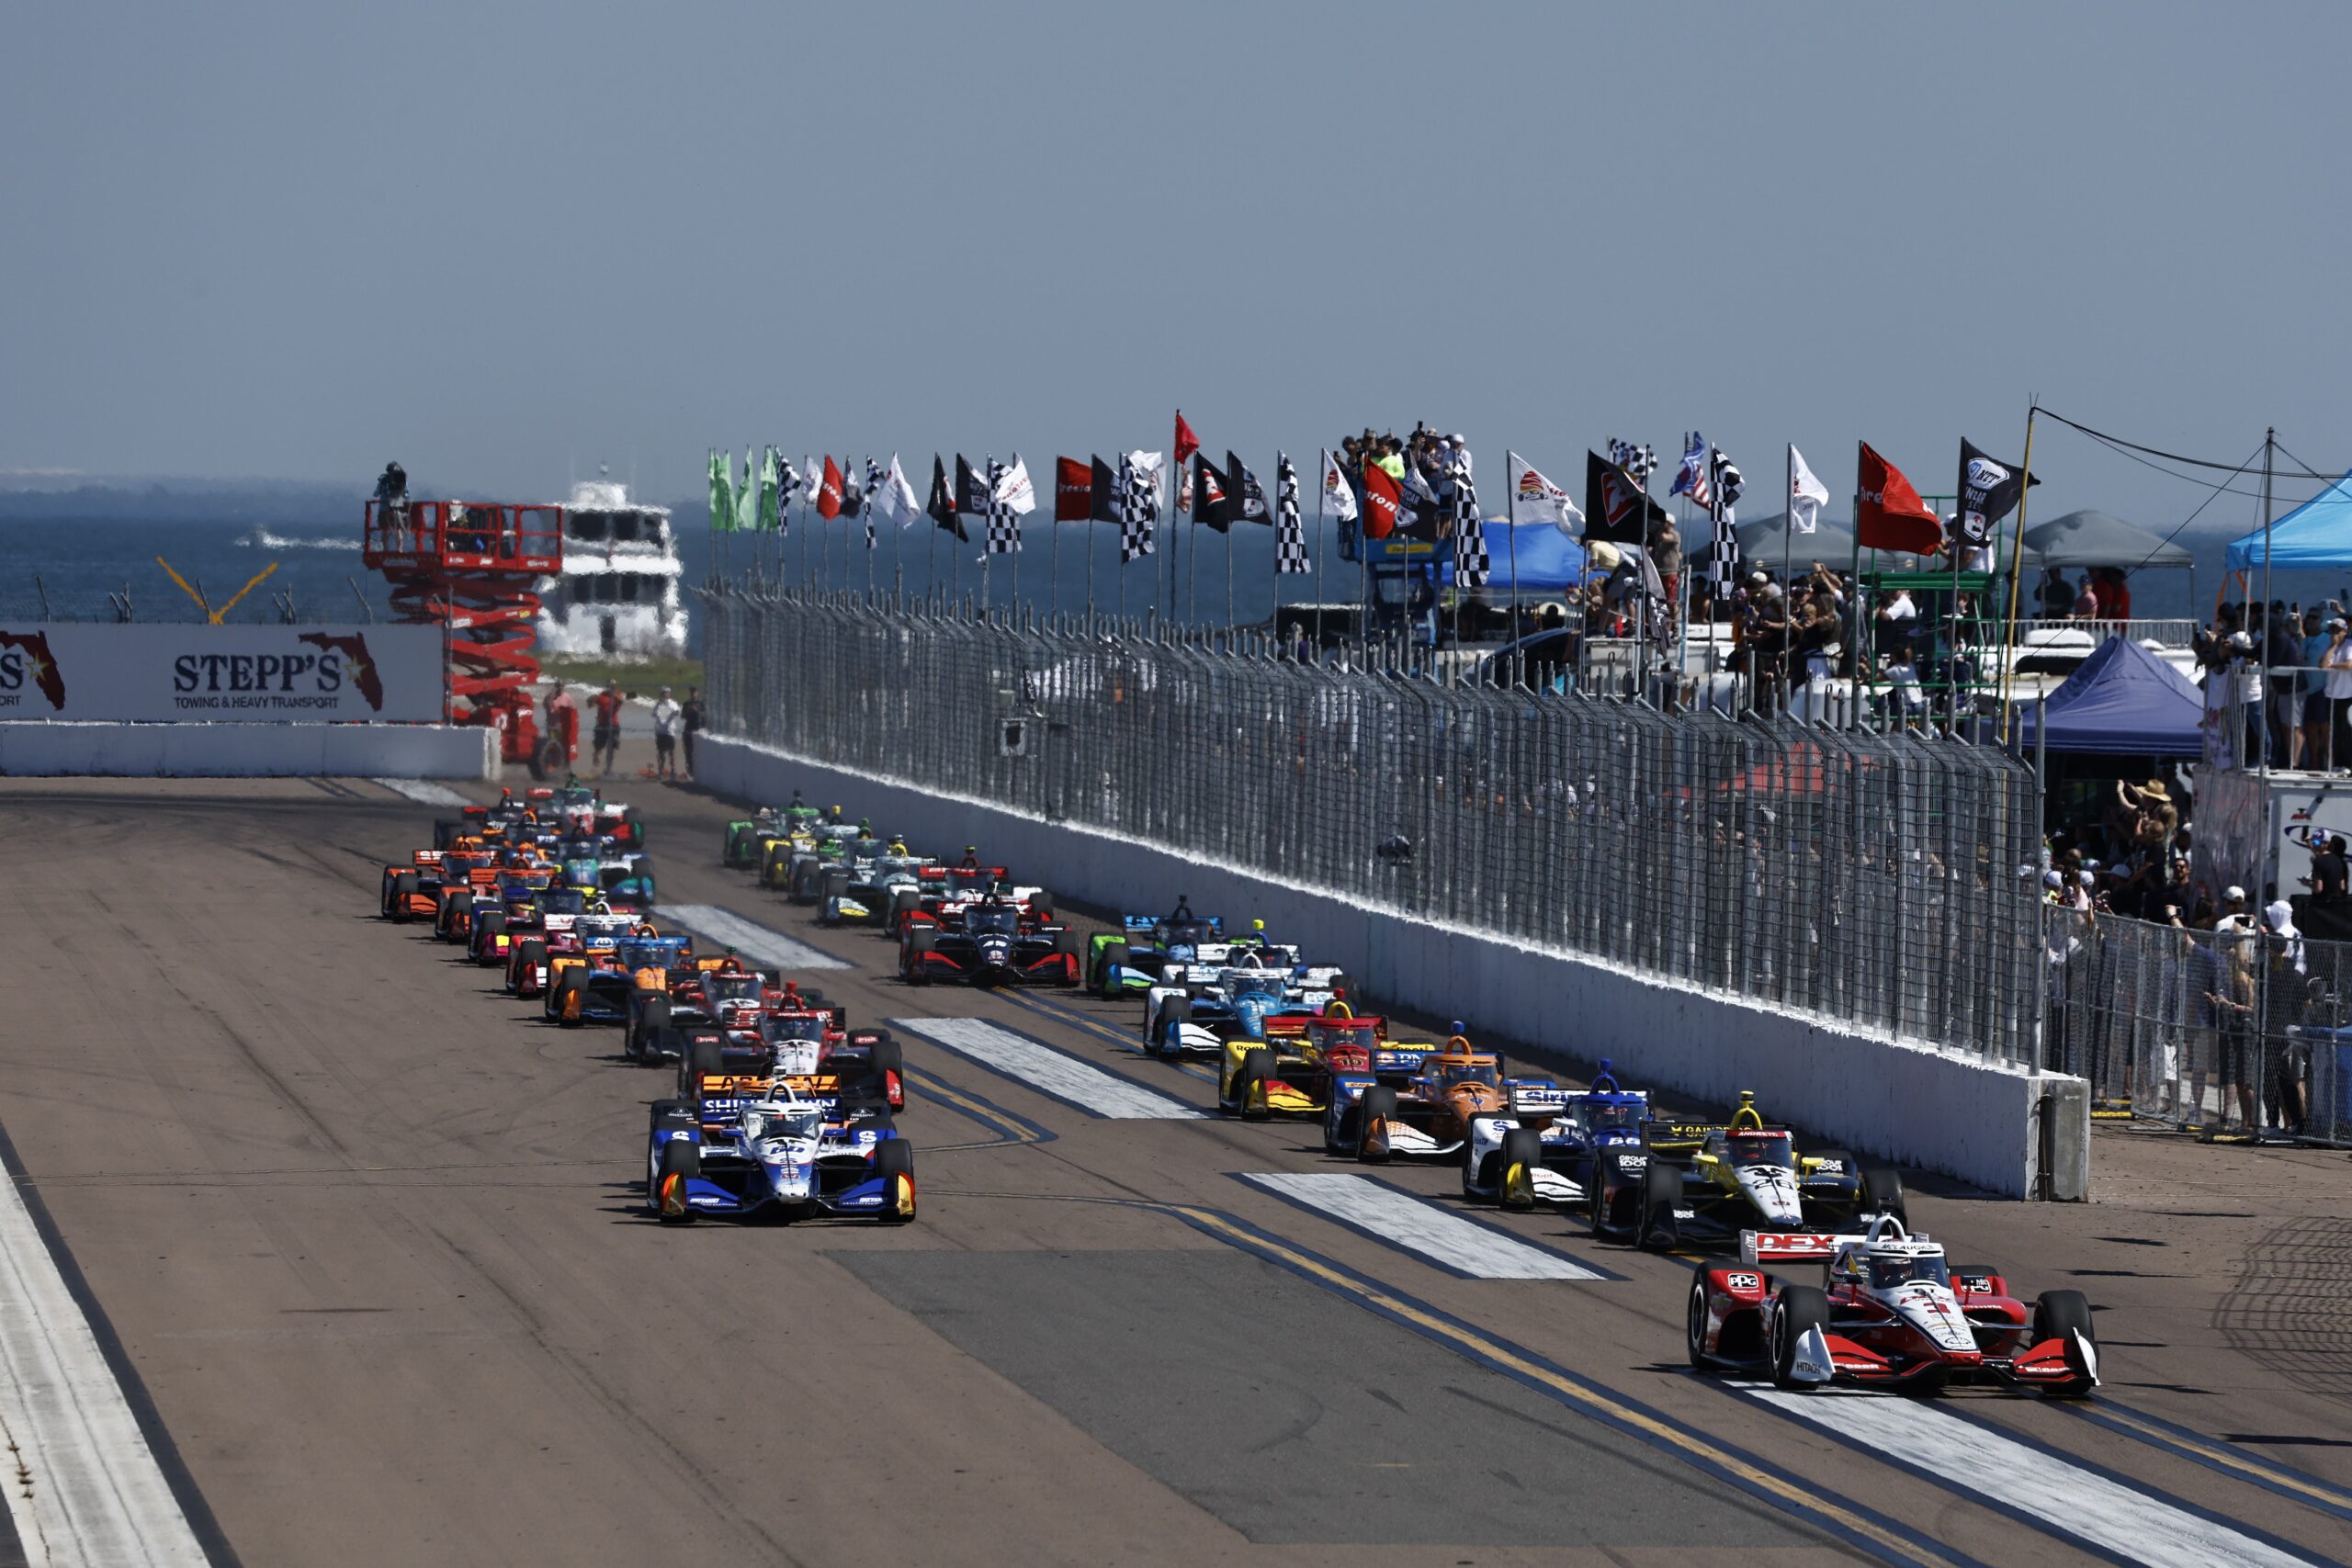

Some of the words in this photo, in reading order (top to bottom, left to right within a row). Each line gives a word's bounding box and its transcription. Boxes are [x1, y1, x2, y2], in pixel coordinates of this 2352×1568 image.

[174, 654, 341, 692] STEPP'S
[175, 696, 220, 708] TOWING
[222, 696, 230, 708] &
[232, 696, 269, 708] HEAVY
[271, 696, 339, 708] TRANSPORT
[1757, 1234, 1836, 1250] DEX
[1730, 1274, 1757, 1288] PPG
